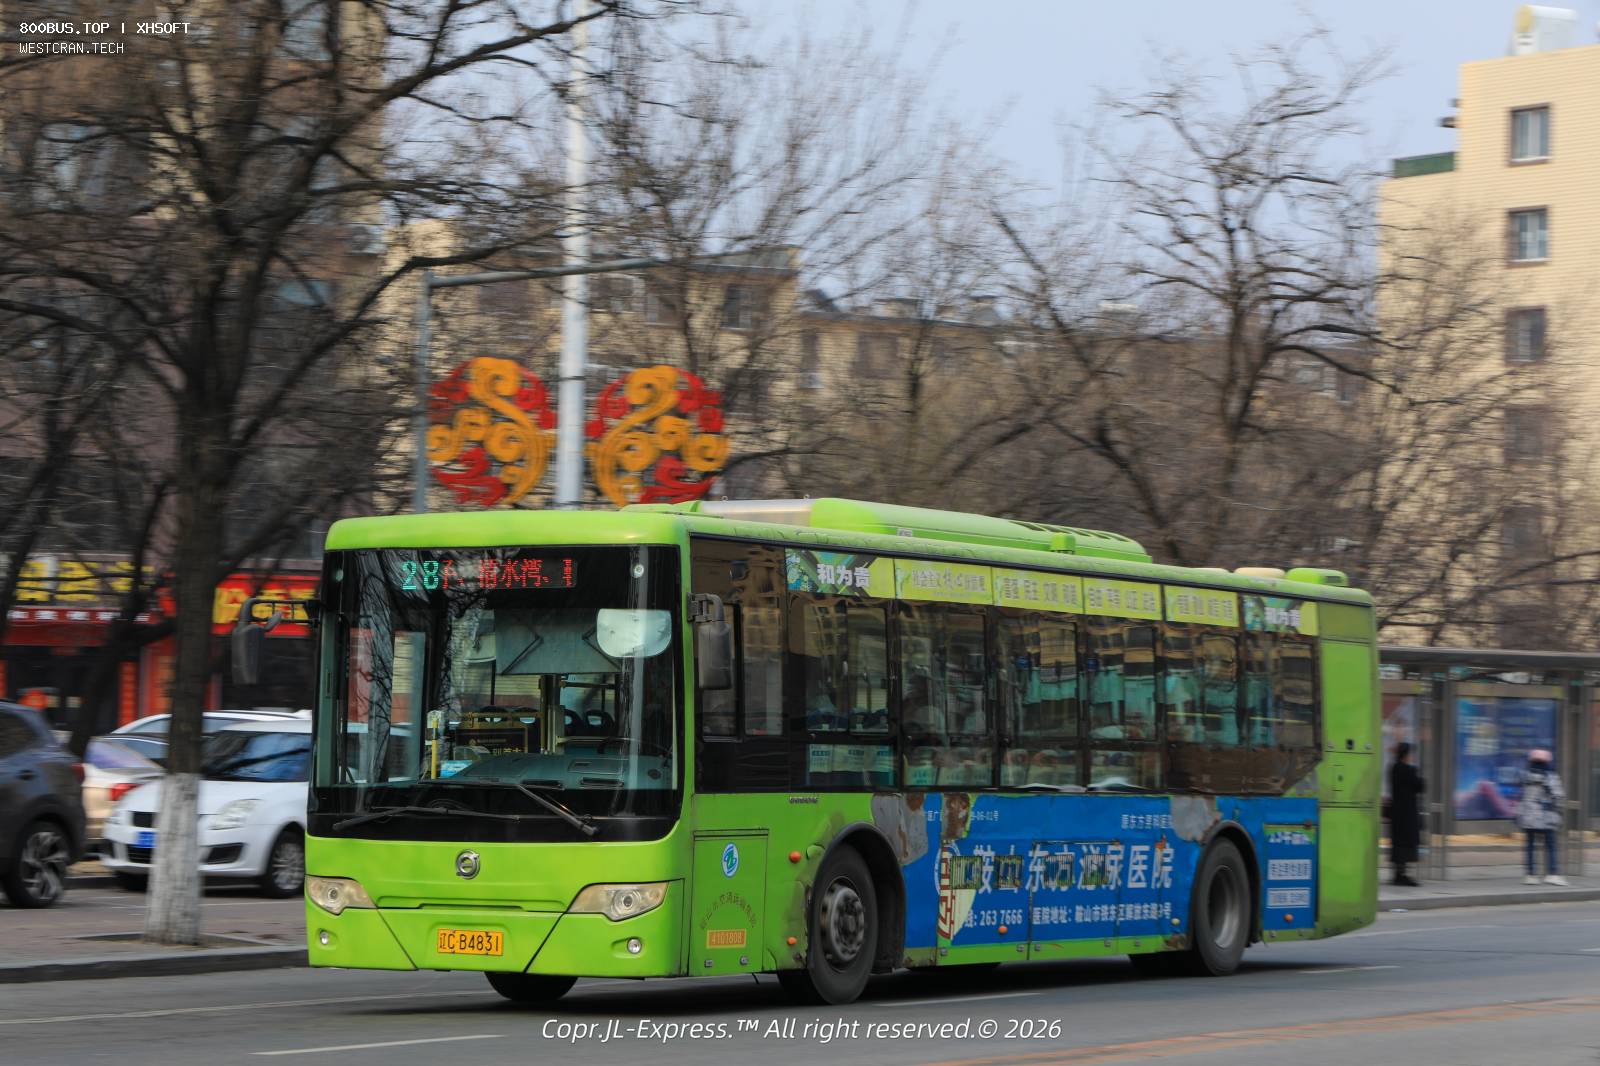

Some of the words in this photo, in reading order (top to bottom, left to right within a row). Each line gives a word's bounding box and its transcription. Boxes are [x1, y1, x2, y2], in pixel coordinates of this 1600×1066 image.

[402, 560, 439, 590] 28
[817, 563, 870, 587] 和为贵
[979, 909, 998, 927] 263
[1000, 908, 1023, 926] 7666
